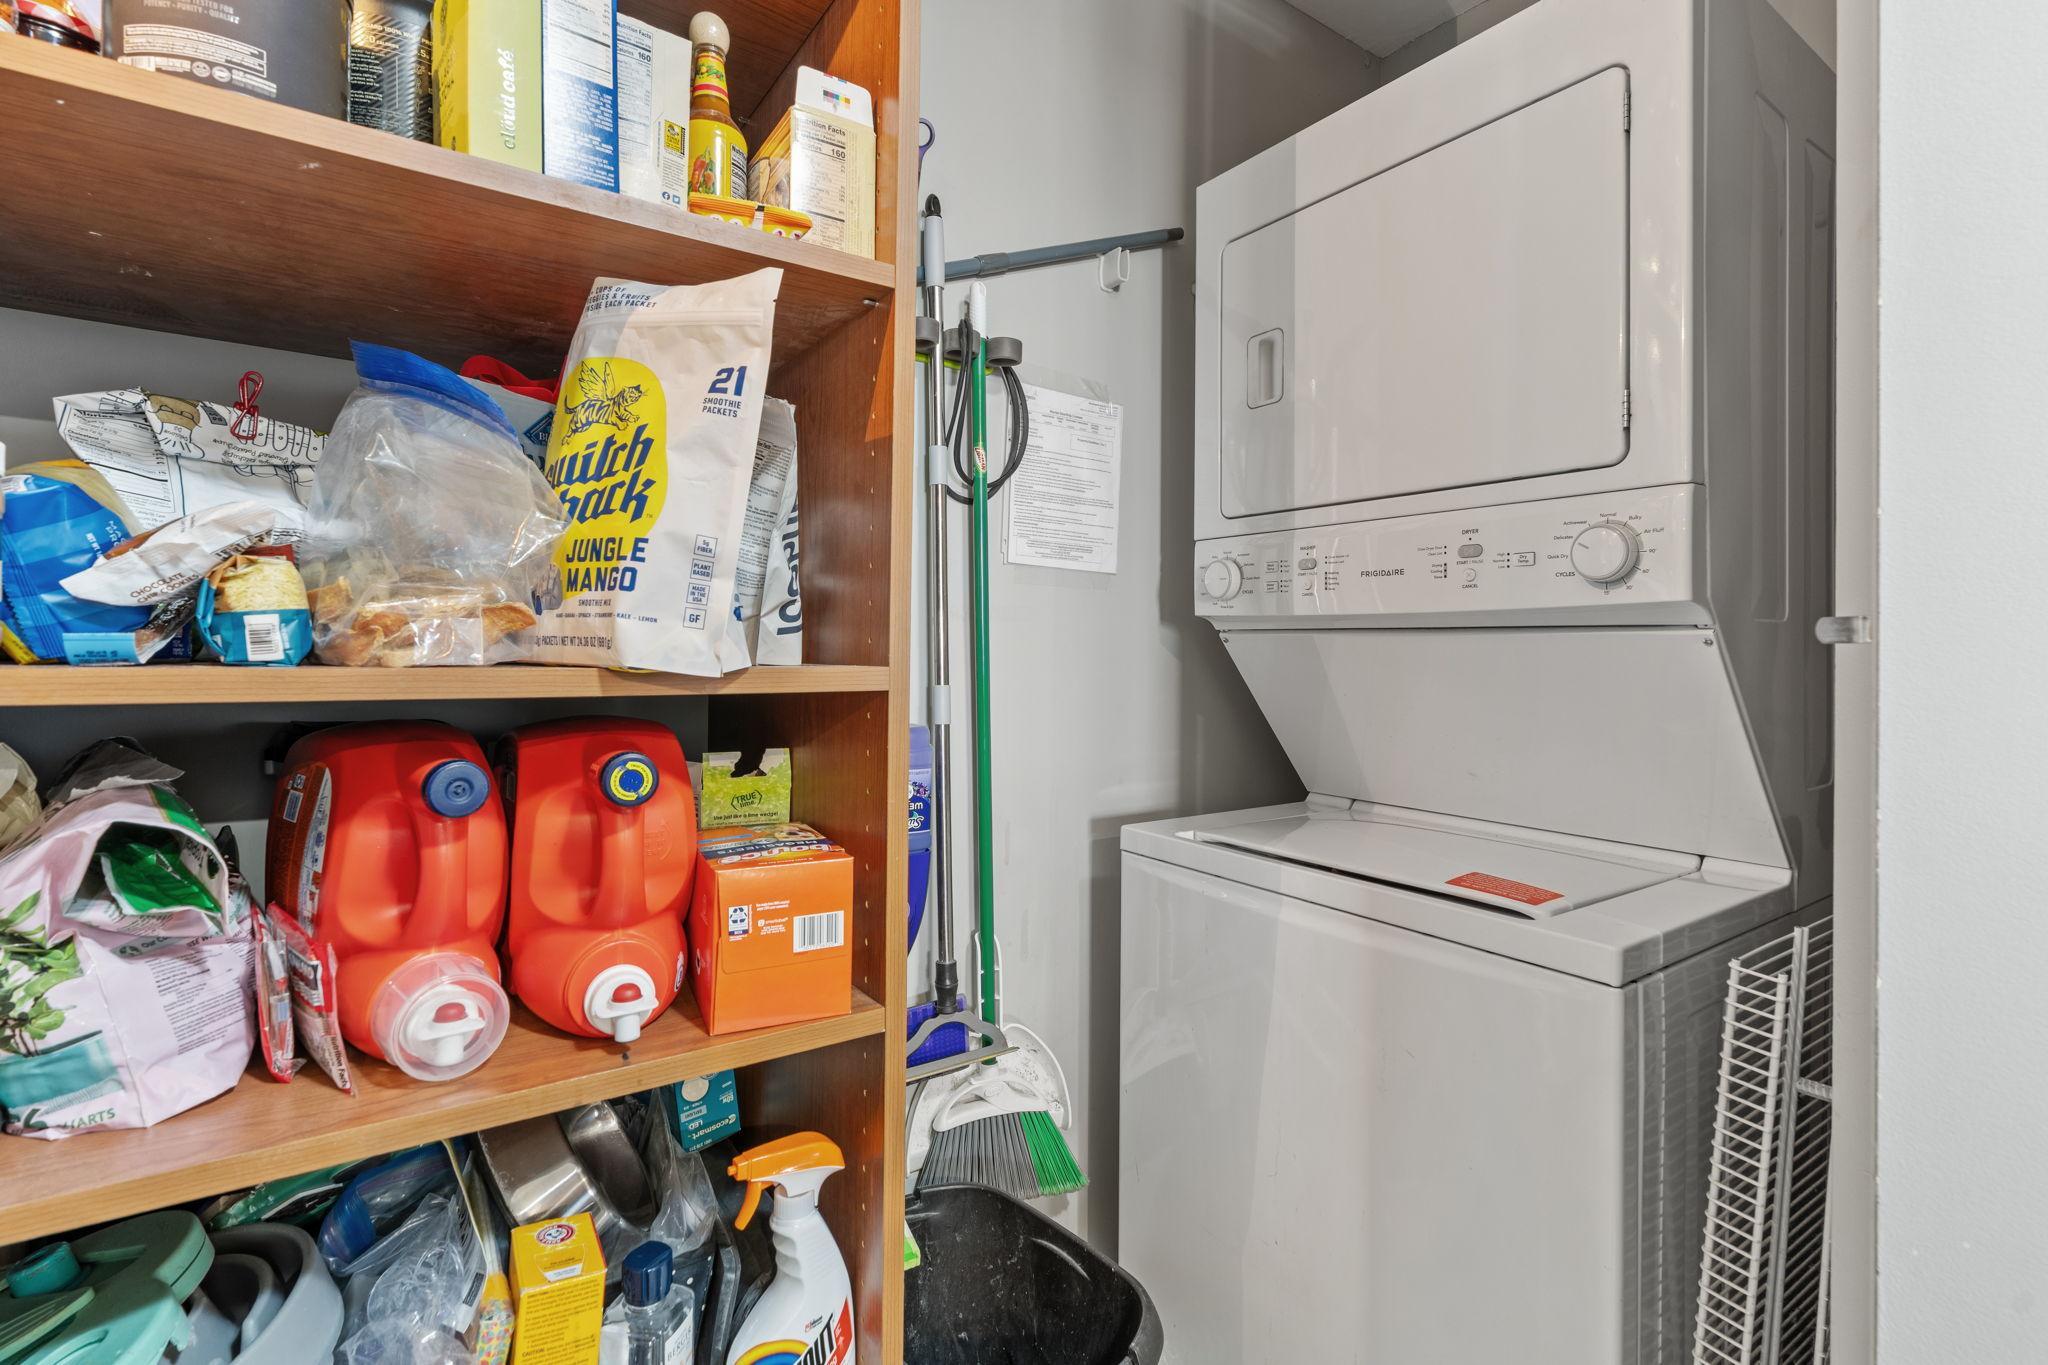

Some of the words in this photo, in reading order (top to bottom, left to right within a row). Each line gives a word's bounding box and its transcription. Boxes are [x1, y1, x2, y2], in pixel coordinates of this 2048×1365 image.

[638, 51, 652, 63] 160
[827, 125, 846, 137] Facts
[831, 148, 846, 159] 160
[595, 285, 613, 294] CUPS
[620, 293, 652, 301] FRUITS
[605, 300, 622, 309] EACH
[625, 299, 658, 309] PACKET
[707, 365, 748, 397] 21
[702, 397, 742, 410] SMOOTHIE
[701, 405, 738, 418] PACKETS
[565, 536, 649, 564] JUNGLE
[697, 545, 713, 554] FIBER
[693, 562, 711, 571] PLANT
[692, 569, 711, 578] BASED
[1360, 568, 1405, 578] FRIGIDAIRE
[159, 573, 200, 595] COOKIES
[565, 565, 638, 593] MANGO
[129, 571, 185, 599] CHOCOLATE
[691, 585, 706, 593] MADE
[578, 598, 602, 607] SMOOTHIE
[616, 612, 632, 620] KALE
[638, 615, 658, 623] LEMON
[688, 613, 701, 624] GF
[561, 636, 569, 647] NET
[735, 790, 758, 805] TRUE
[723, 813, 733, 821] just
[732, 812, 742, 820] like
[748, 811, 759, 819] lime
[687, 1119, 704, 1130] LED
[692, 1118, 730, 1140] ecosmart
